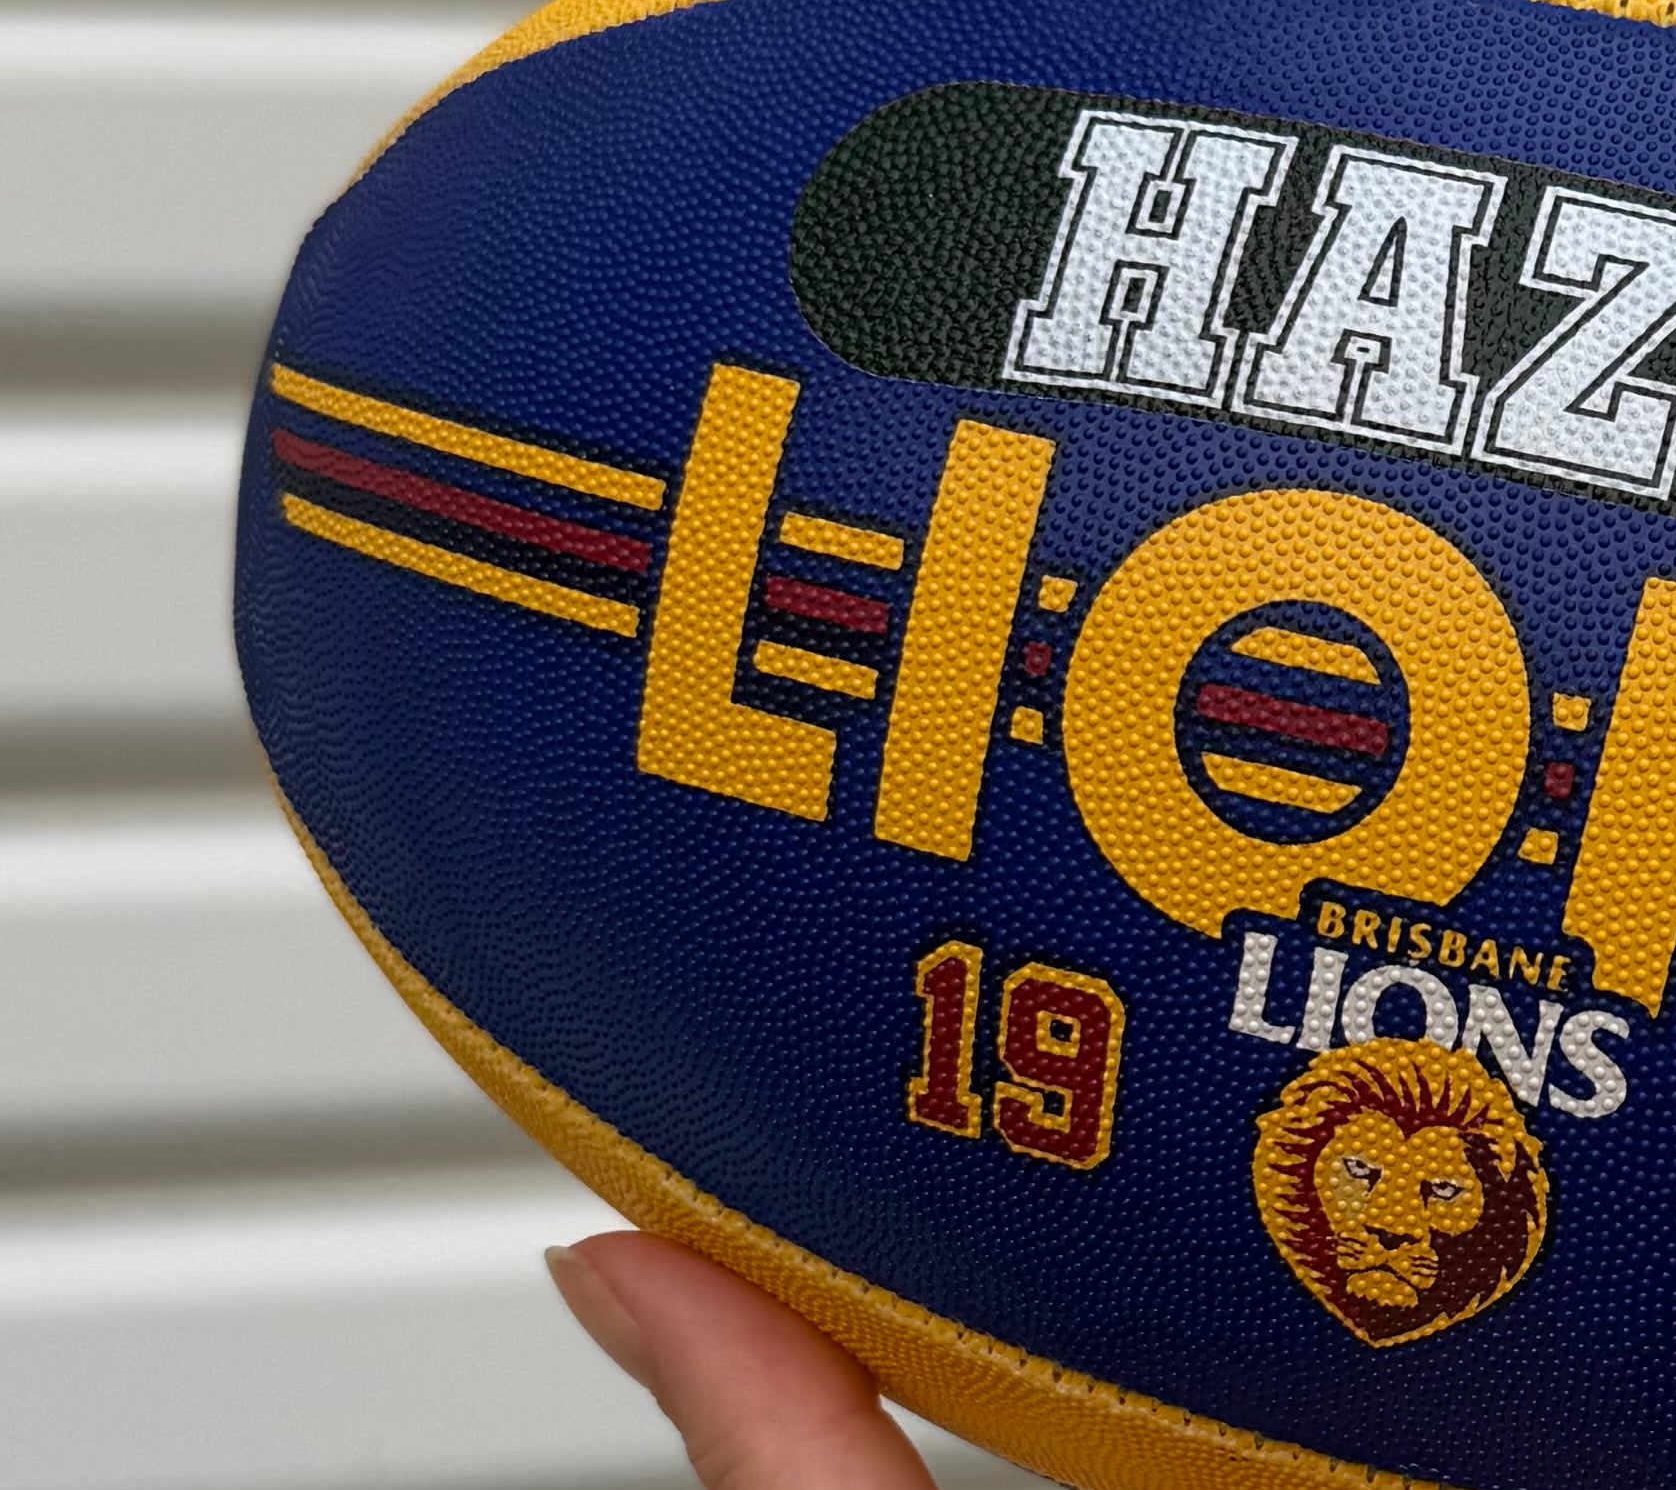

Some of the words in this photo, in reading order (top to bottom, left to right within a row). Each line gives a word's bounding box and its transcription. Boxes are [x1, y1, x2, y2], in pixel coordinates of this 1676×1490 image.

[1229, 932, 1630, 1118] LIONS
[1317, 901, 1572, 993] BRISBANE
[907, 940, 1127, 1172] 19
